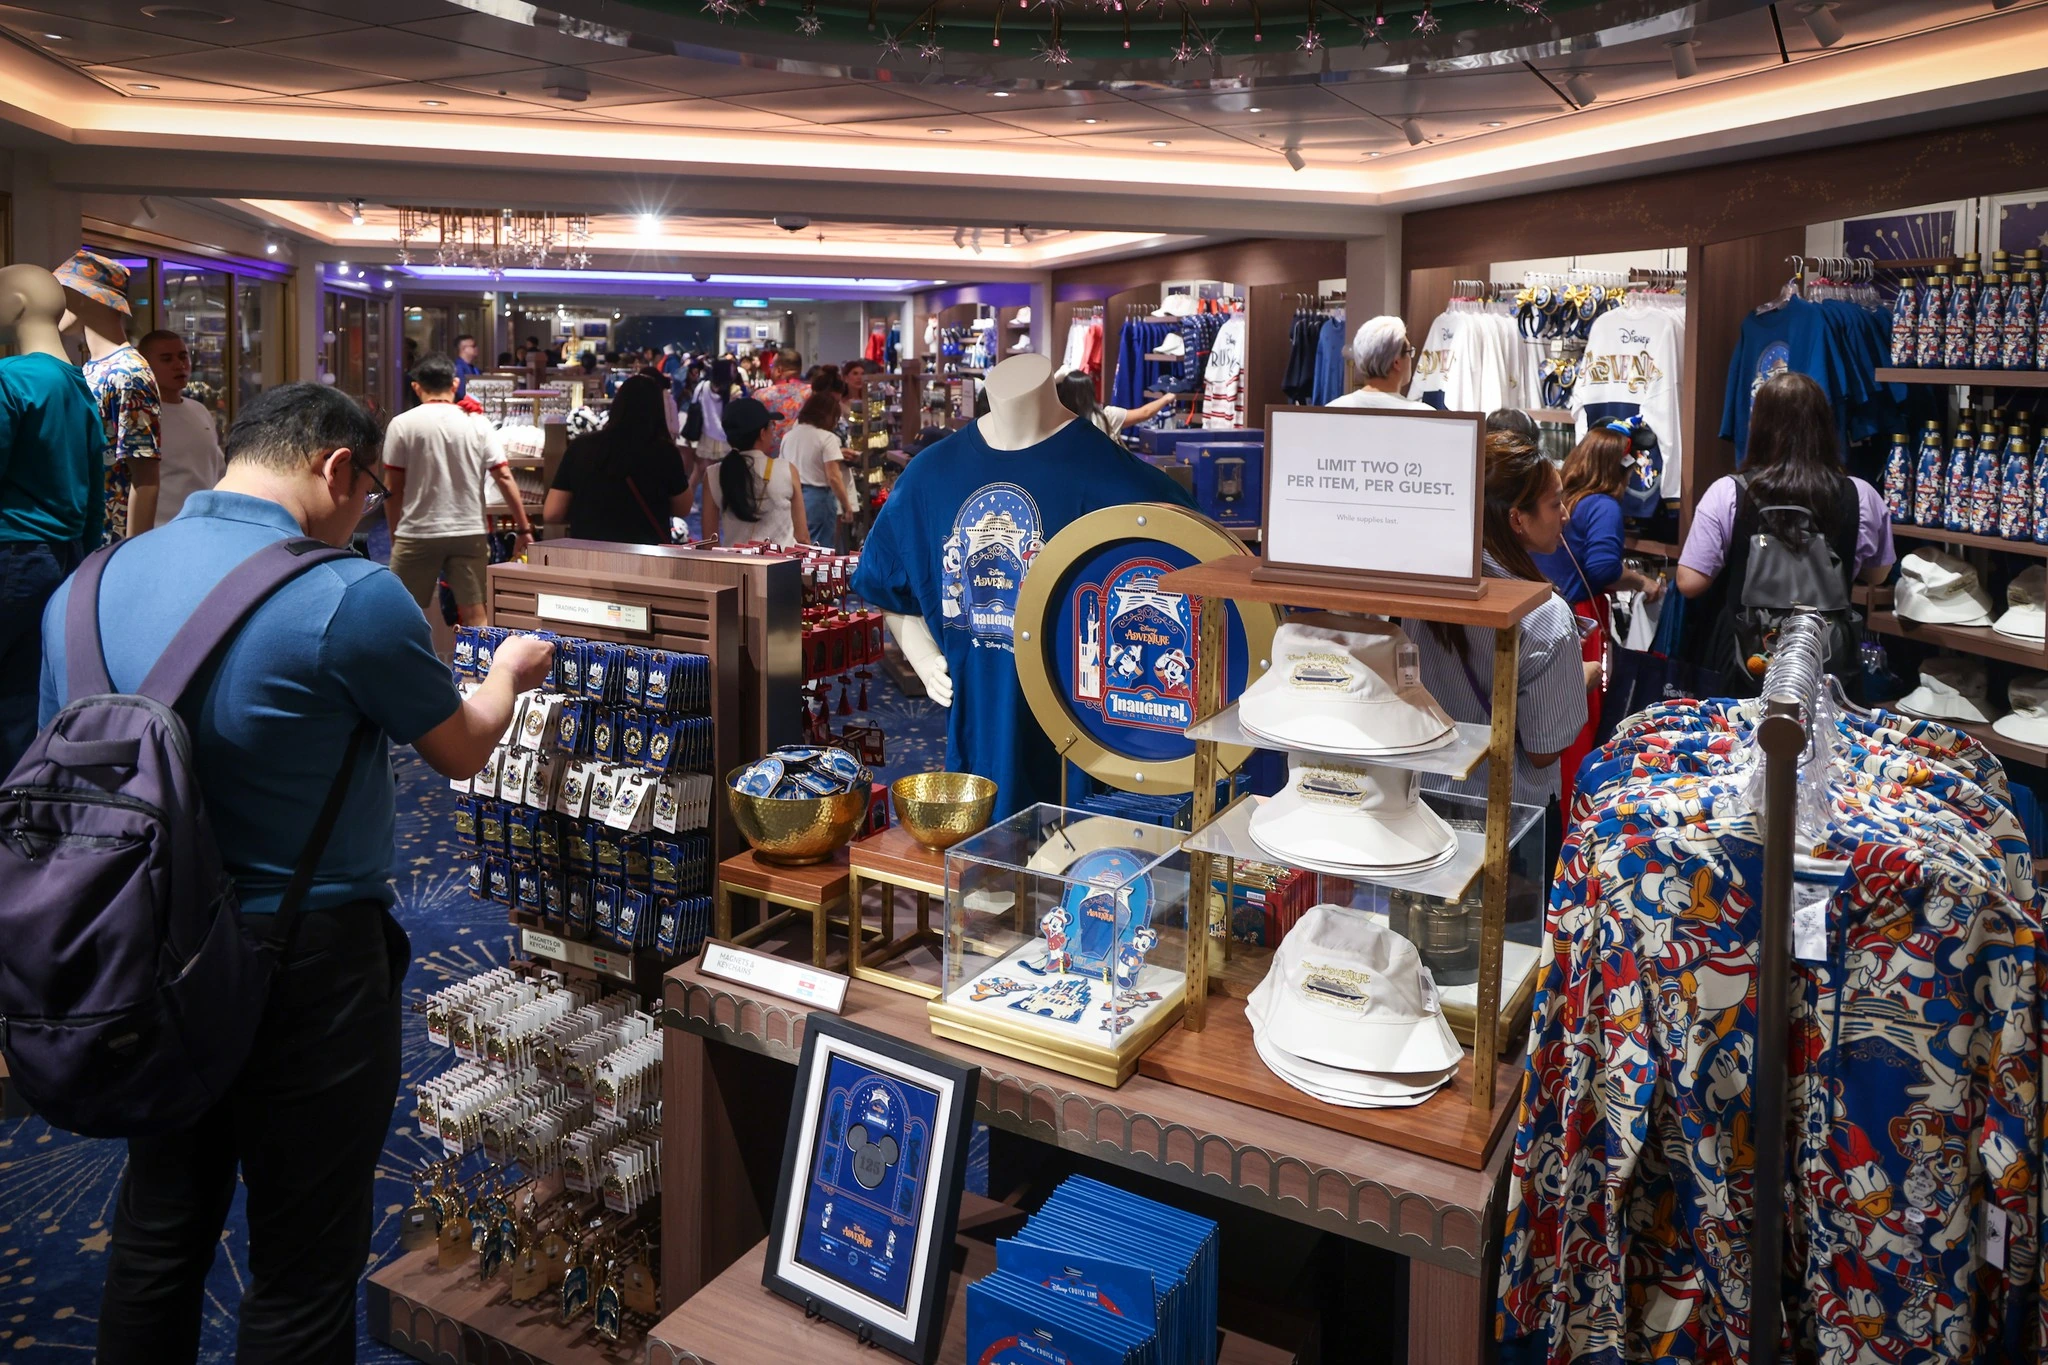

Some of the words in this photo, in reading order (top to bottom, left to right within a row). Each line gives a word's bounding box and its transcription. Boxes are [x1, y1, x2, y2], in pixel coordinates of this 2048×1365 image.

[1618, 328, 1651, 349] Disney
[1317, 458, 1356, 472] LIMIT
[1361, 460, 1399, 474] TWO
[1404, 462, 1422, 477] (2)
[1287, 474, 1314, 488] PER
[1319, 476, 1359, 492] ITEM,
[1365, 479, 1394, 493] PER
[1399, 481, 1455, 496] GUEST.
[1336, 513, 1355, 522] While
[1357, 516, 1384, 525] supplies
[555, 603, 577, 612] TRADING
[1125, 629, 1170, 646] ADVENTURE
[1139, 623, 1158, 635] Disney
[1109, 693, 1188, 722] Inaugural
[529, 934, 552, 946] MAGNETS
[529, 940, 557, 953] KEYCHAINS
[716, 960, 752, 976] KEYCHAINS
[720, 952, 749, 967] MAGNETS
[860, 1155, 880, 1176] 125
[1050, 1282, 1068, 1295] Disney
[1068, 1287, 1086, 1297] CRUISE
[1086, 1290, 1098, 1300] LINE
[1018, 1338, 1036, 1353] Disney
[1036, 1347, 1053, 1360] CRUISE
[1054, 1355, 1066, 1365] LINE
